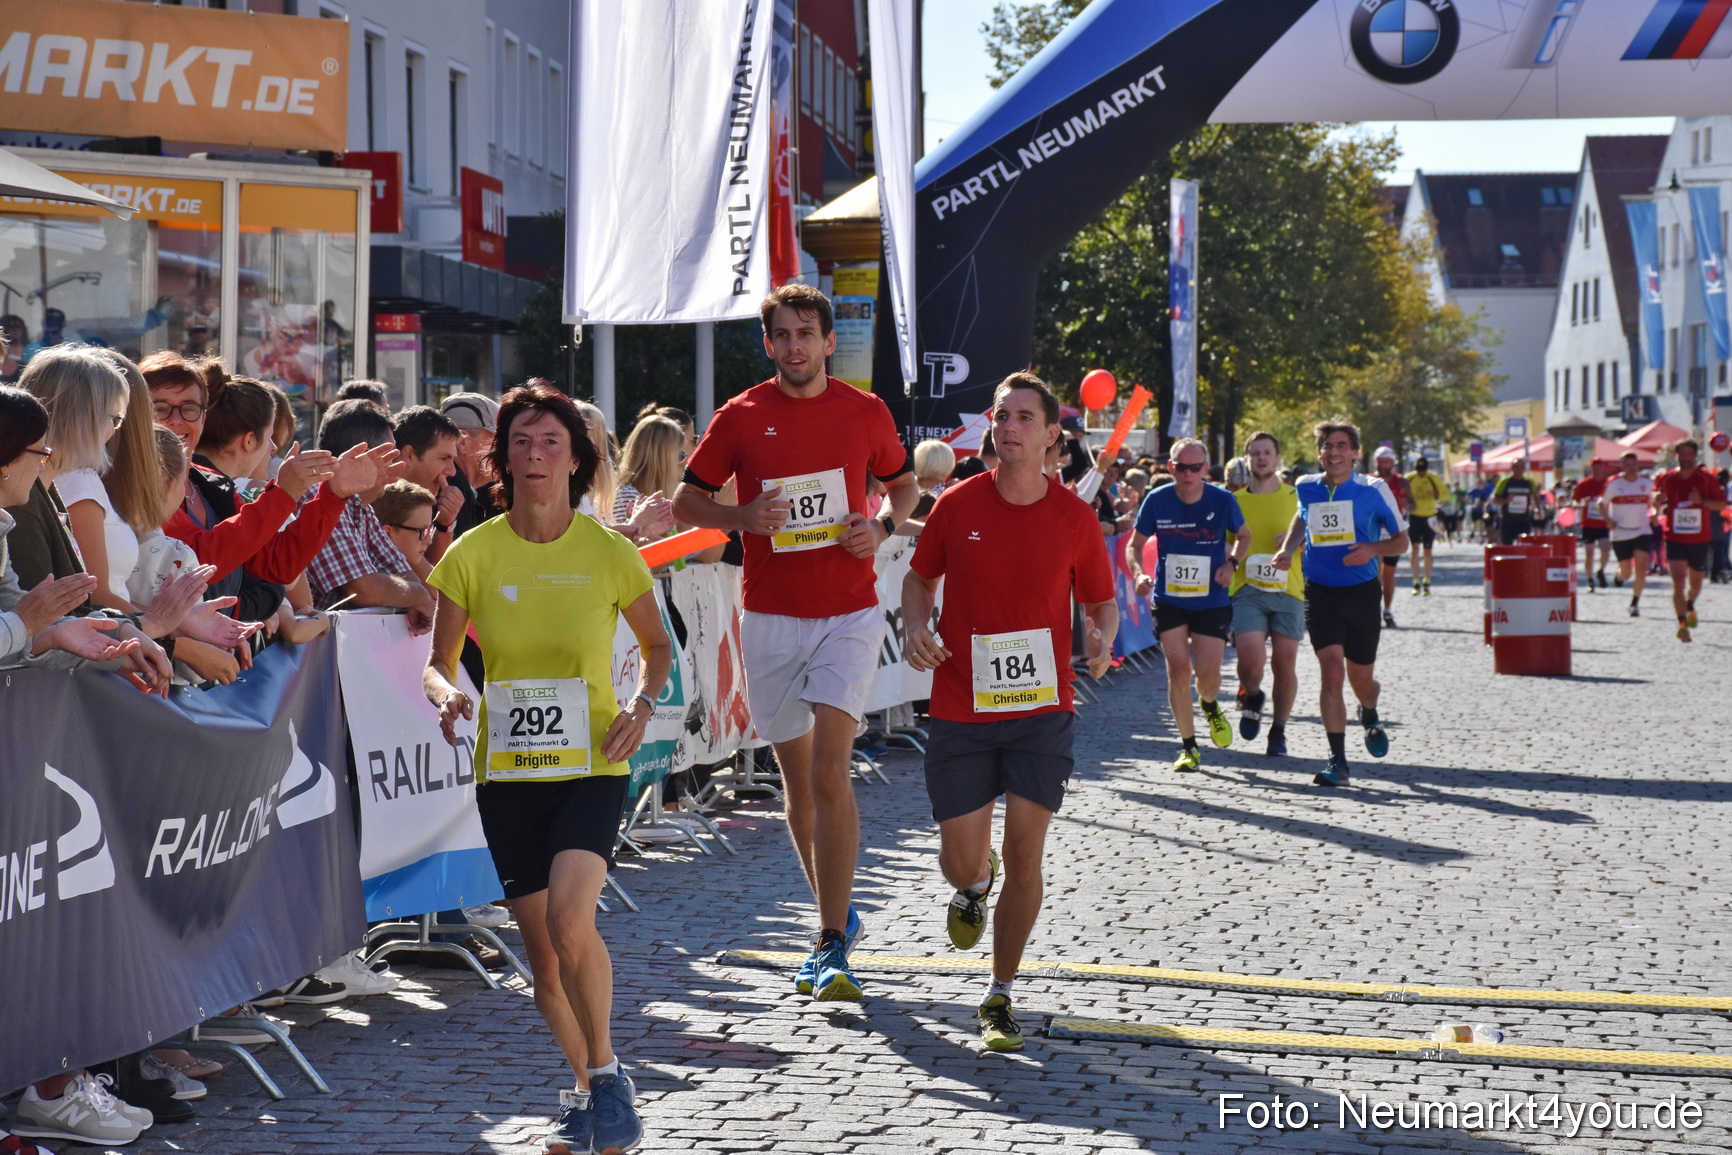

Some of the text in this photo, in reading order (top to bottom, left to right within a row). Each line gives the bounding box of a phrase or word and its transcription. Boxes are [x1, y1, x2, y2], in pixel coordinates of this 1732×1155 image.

[931, 64, 1167, 221] PARTL NEUMARKT
[728, 194, 751, 297] PARTL
[926, 426, 954, 438] NEXT
[786, 480, 821, 493] BOCK
[788, 493, 827, 521] 187
[803, 519, 828, 528] Neumarkt
[1322, 514, 1339, 528] 33
[794, 530, 829, 544] Philipp
[1175, 566, 1200, 580] 317
[1256, 564, 1279, 578] 137
[992, 638, 1030, 650] BOCK
[990, 653, 1037, 681] 184
[513, 687, 558, 699] BOCK
[990, 682, 1008, 690] PARTL
[993, 692, 1038, 705] Christian
[509, 705, 564, 737] 292
[508, 740, 528, 748] PARTL
[515, 753, 560, 769] Brigitte
[144, 781, 280, 879] RAIL.ONE
